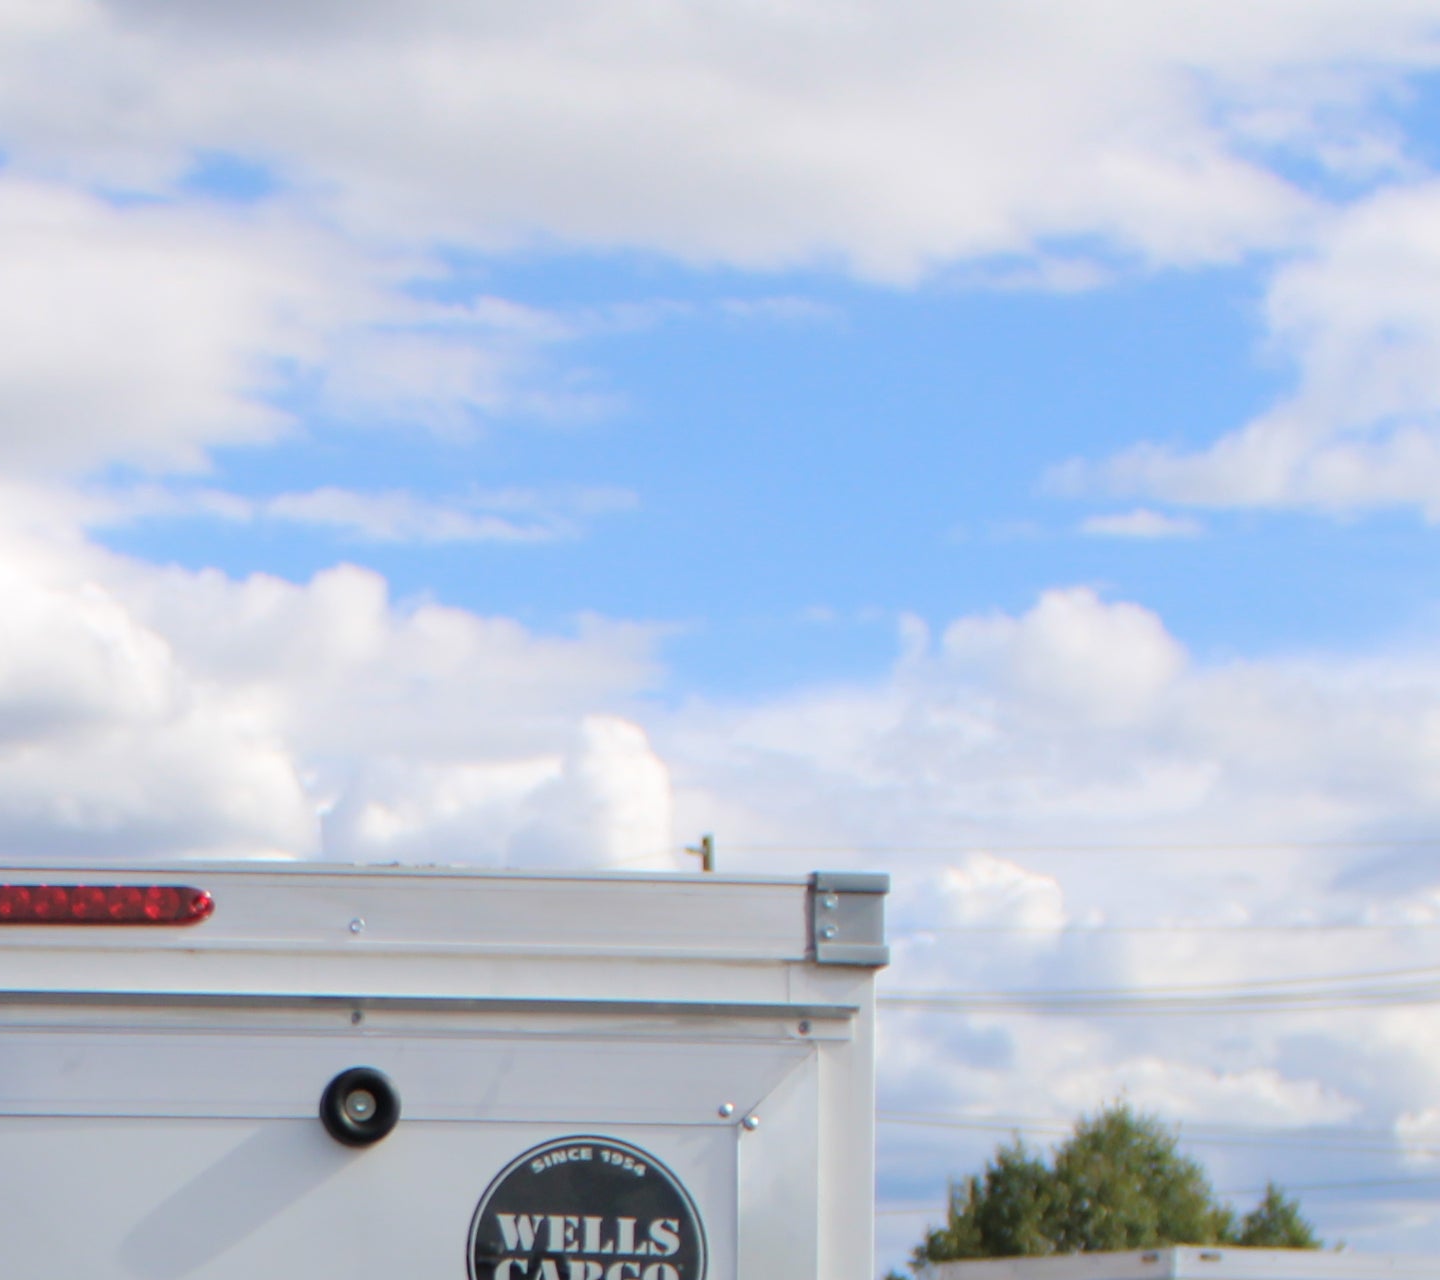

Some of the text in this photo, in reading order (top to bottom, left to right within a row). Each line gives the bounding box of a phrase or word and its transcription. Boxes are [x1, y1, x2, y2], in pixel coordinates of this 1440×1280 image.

[530, 1147, 648, 1177] SINCE 1954
[496, 1213, 681, 1256] WELLS
